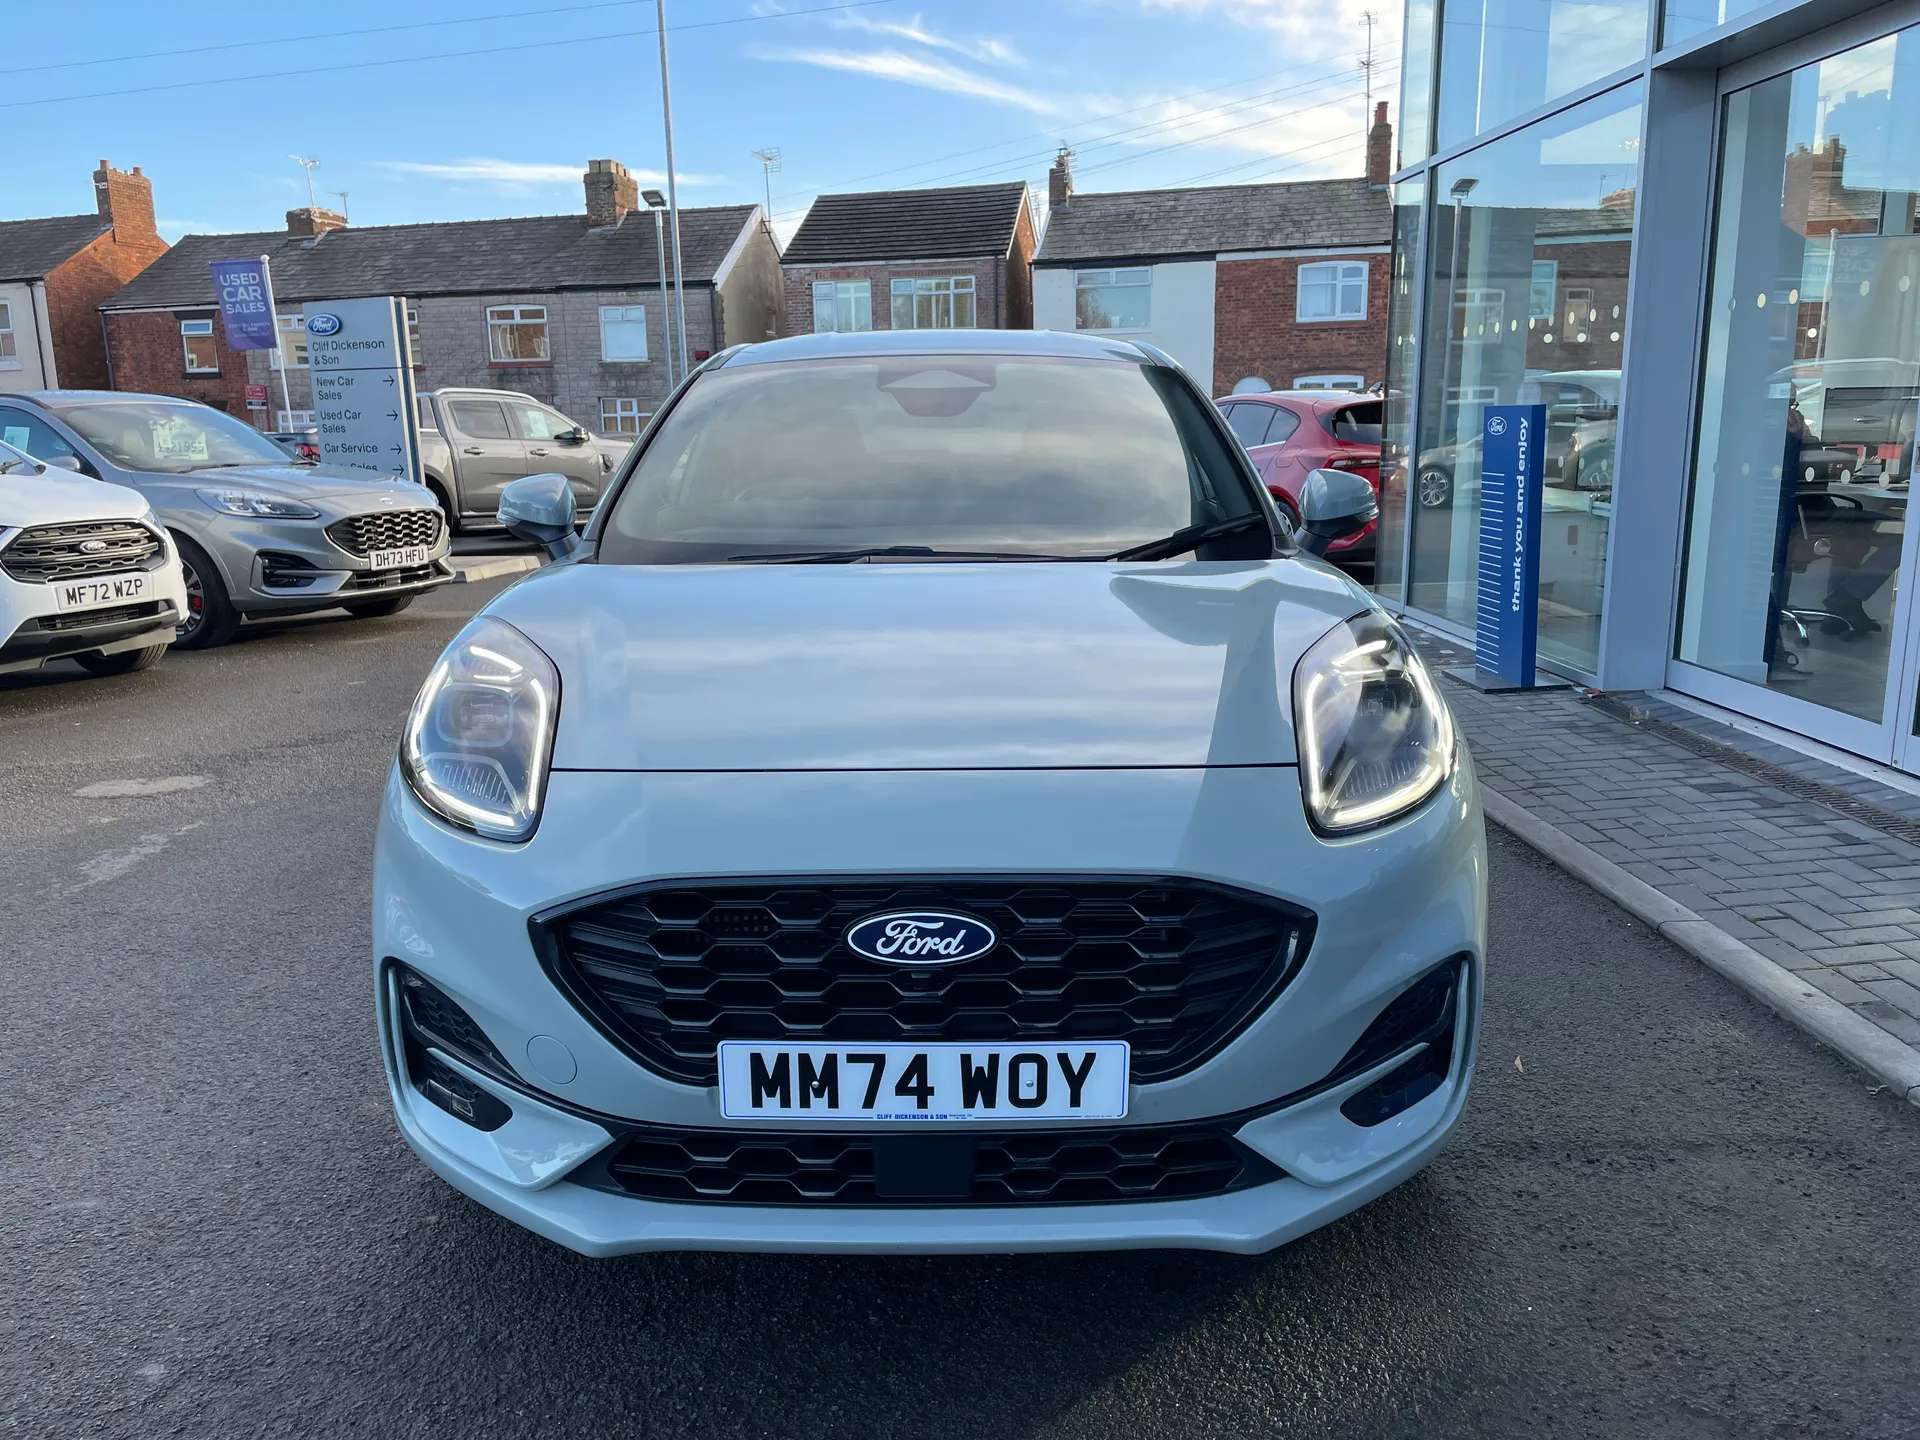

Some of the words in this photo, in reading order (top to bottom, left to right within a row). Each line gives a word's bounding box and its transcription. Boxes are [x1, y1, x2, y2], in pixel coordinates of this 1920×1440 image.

[219, 272, 260, 286] USED
[222, 285, 263, 302] CAR
[225, 302, 266, 314] SALES
[312, 317, 333, 332] Ford
[312, 340, 329, 352] Cliff
[330, 340, 385, 351] Dickenson
[314, 355, 320, 366] &
[321, 354, 340, 365] Son
[316, 376, 336, 387] New
[337, 375, 355, 386] Car
[318, 389, 342, 400] Sales
[320, 410, 342, 421] Used
[344, 409, 361, 420] Car
[322, 423, 346, 434] Sales
[324, 442, 340, 453] Car
[341, 442, 378, 454] Service
[1518, 416, 1529, 471] enjoy
[1516, 475, 1525, 514] and
[1515, 516, 1524, 553] you
[375, 551, 403, 567] DH73
[405, 547, 425, 563] HFU
[65, 583, 110, 606] MF72
[113, 578, 143, 599] WZP
[1511, 556, 1522, 613] thank
[876, 920, 967, 955] Ford
[749, 1052, 935, 1110] MM74
[959, 1052, 1098, 1110] WOY
